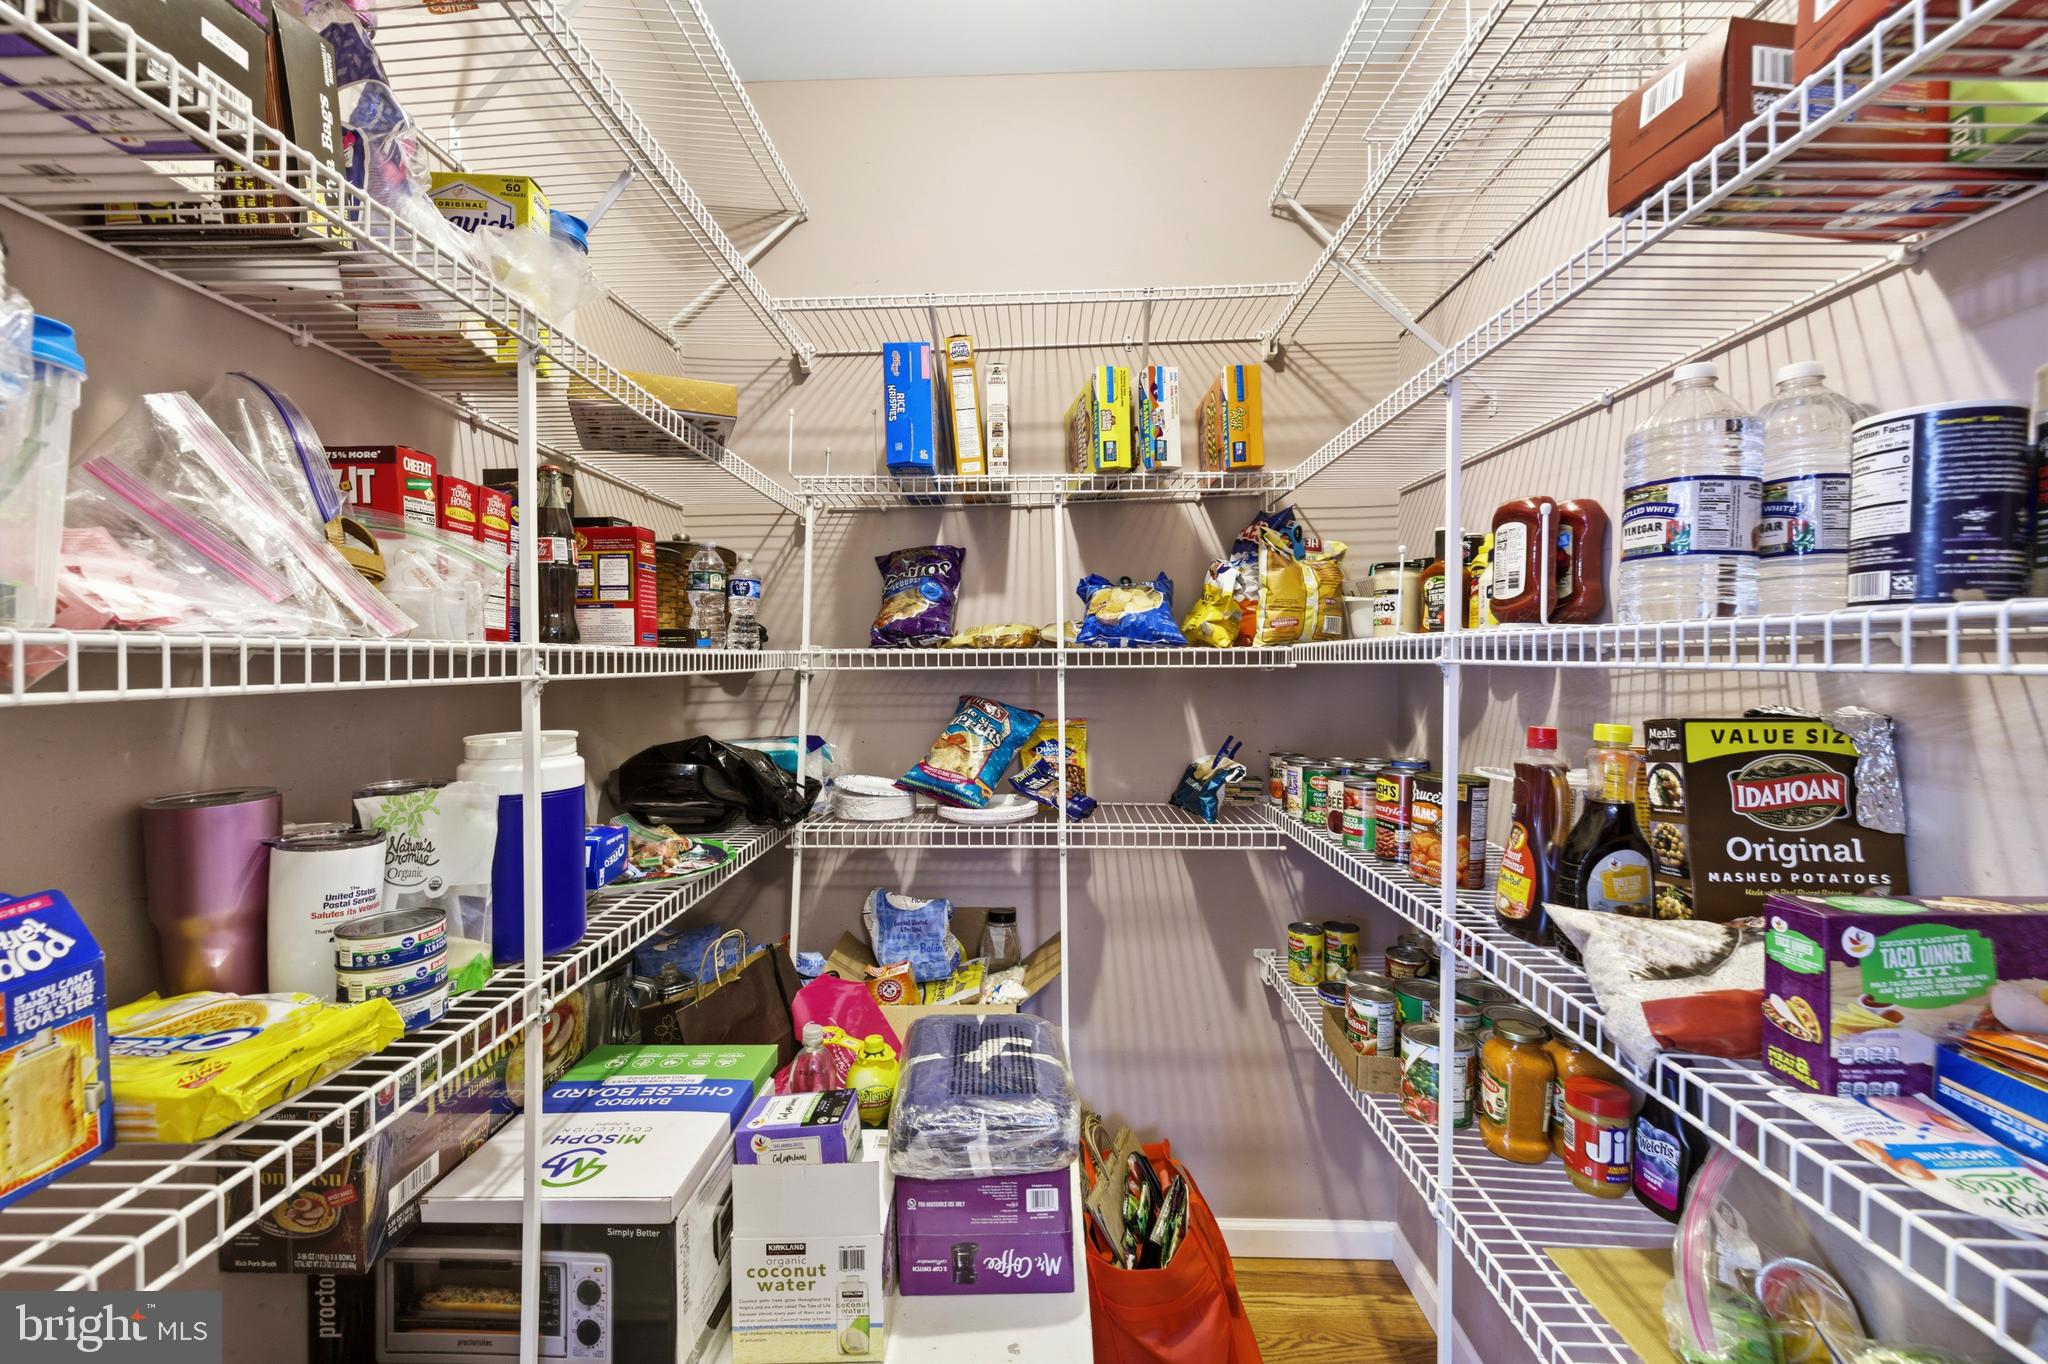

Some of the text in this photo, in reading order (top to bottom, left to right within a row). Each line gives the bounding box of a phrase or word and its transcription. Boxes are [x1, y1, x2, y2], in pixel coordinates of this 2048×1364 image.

[320, 92, 333, 154] Bags
[506, 183, 521, 193] 60
[437, 200, 484, 209] ORIGINAL
[888, 385, 897, 422] KRISPIES
[896, 392, 905, 414] RICE
[1142, 399, 1150, 434] FAMILY
[1853, 423, 1912, 443] Nutrition Facts
[325, 451, 347, 459] 75%
[1902, 455, 1910, 464] 0
[403, 456, 433, 477] CHEEZ-IT
[450, 488, 472, 501] TOWN
[450, 497, 472, 510] HOUSE
[486, 498, 506, 511] TOWN
[1645, 505, 1676, 515] WHITE
[1763, 504, 1796, 513] WHITE
[426, 515, 436, 523] 150
[486, 506, 506, 520] HOUSE
[1624, 521, 1663, 538] VINEGAR
[1648, 727, 1677, 740] Meals
[1711, 728, 1854, 745] VALUE SIZ
[1377, 783, 1396, 798] SH'S
[1736, 778, 1840, 809] IDAHOAN
[387, 832, 436, 853] Nature's
[385, 850, 441, 867] Promise
[604, 843, 625, 868] OREO
[1726, 836, 1866, 869] Original
[387, 867, 424, 881] Organic
[1708, 871, 1893, 885] MASHED POTATOES
[325, 887, 377, 902] United States
[322, 898, 351, 910] Postal
[310, 907, 357, 920] Salutes its
[1880, 942, 1974, 969] TACO DINNER
[1903, 965, 1953, 978] KIT
[13, 969, 93, 1007] IF YOU CAN'T
[13, 978, 97, 1013] STAND THE HEAT
[13, 985, 95, 1022] GET OUT OF THE
[13, 993, 95, 1035] TOASTER
[111, 1028, 256, 1051] ORE
[1768, 1048, 1796, 1067] MEAT
[1768, 1058, 1821, 1090] TOPPINGS
[552, 1085, 734, 1099] CHEESE BOARD
[594, 1097, 673, 1107] BAMBOO
[550, 1133, 647, 1146] MISOPH
[1586, 1130, 1626, 1164] Ji
[1638, 1135, 1675, 1159] Welch's
[1945, 1172, 2045, 1201] Success
[955, 1200, 966, 1209] ONLY
[1983, 1196, 2048, 1220] resh
[606, 1227, 661, 1239] Simply Better
[768, 1244, 805, 1252] KIRKLAND
[234, 1259, 278, 1269] Rich Pork Broth
[338, 1253, 357, 1262] BOWLS
[766, 1256, 807, 1267] organic
[982, 1248, 1063, 1280] Mr. Coffee
[746, 1264, 827, 1279] coconut
[757, 1278, 816, 1292] water
[836, 1301, 870, 1309] coconut
